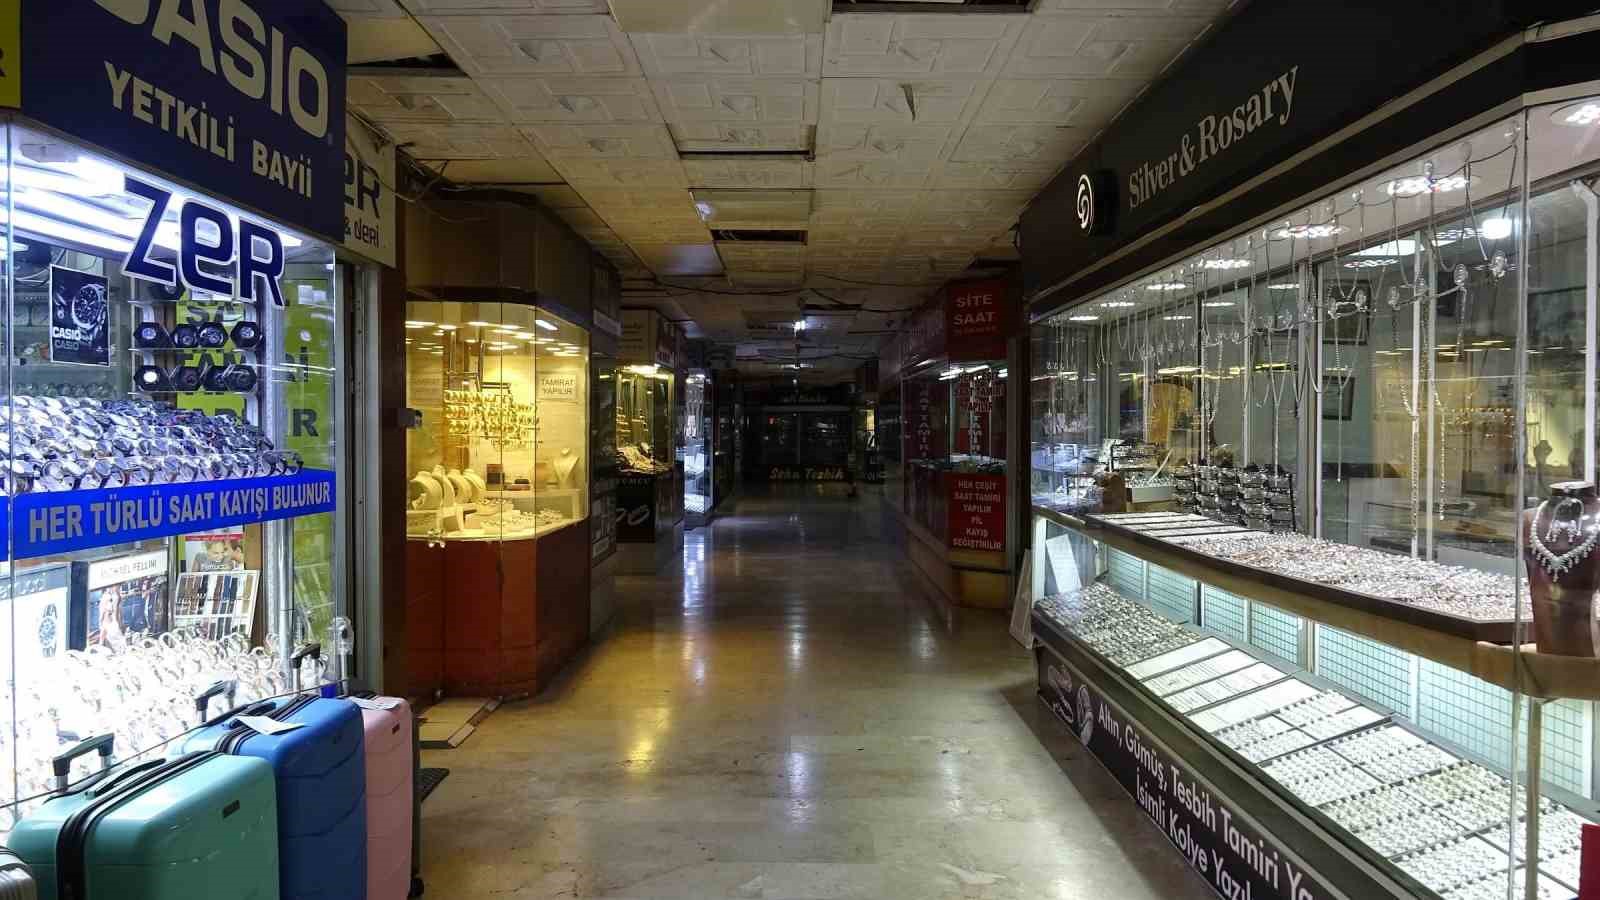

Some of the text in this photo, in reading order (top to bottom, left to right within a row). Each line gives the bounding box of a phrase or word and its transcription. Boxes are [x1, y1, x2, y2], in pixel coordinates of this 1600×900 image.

[96, 0, 329, 138] ASIO
[104, 60, 235, 162] YETKİLİ
[1128, 65, 1299, 209] Silver & Rosary
[953, 311, 995, 326] SAAT
[956, 293, 993, 308] SİTE
[52, 326, 81, 341] CASIO
[953, 491, 975, 501] SAAT
[957, 480, 973, 489] HER
[28, 481, 330, 543] HER TÜRLÜ SAAT KAYIŞI BULUNUR
[962, 504, 992, 513] YAPILIR
[1169, 808, 1207, 873] Kolye
[1171, 764, 1216, 833] Tesbih
[1220, 807, 1279, 888] Tamiri
